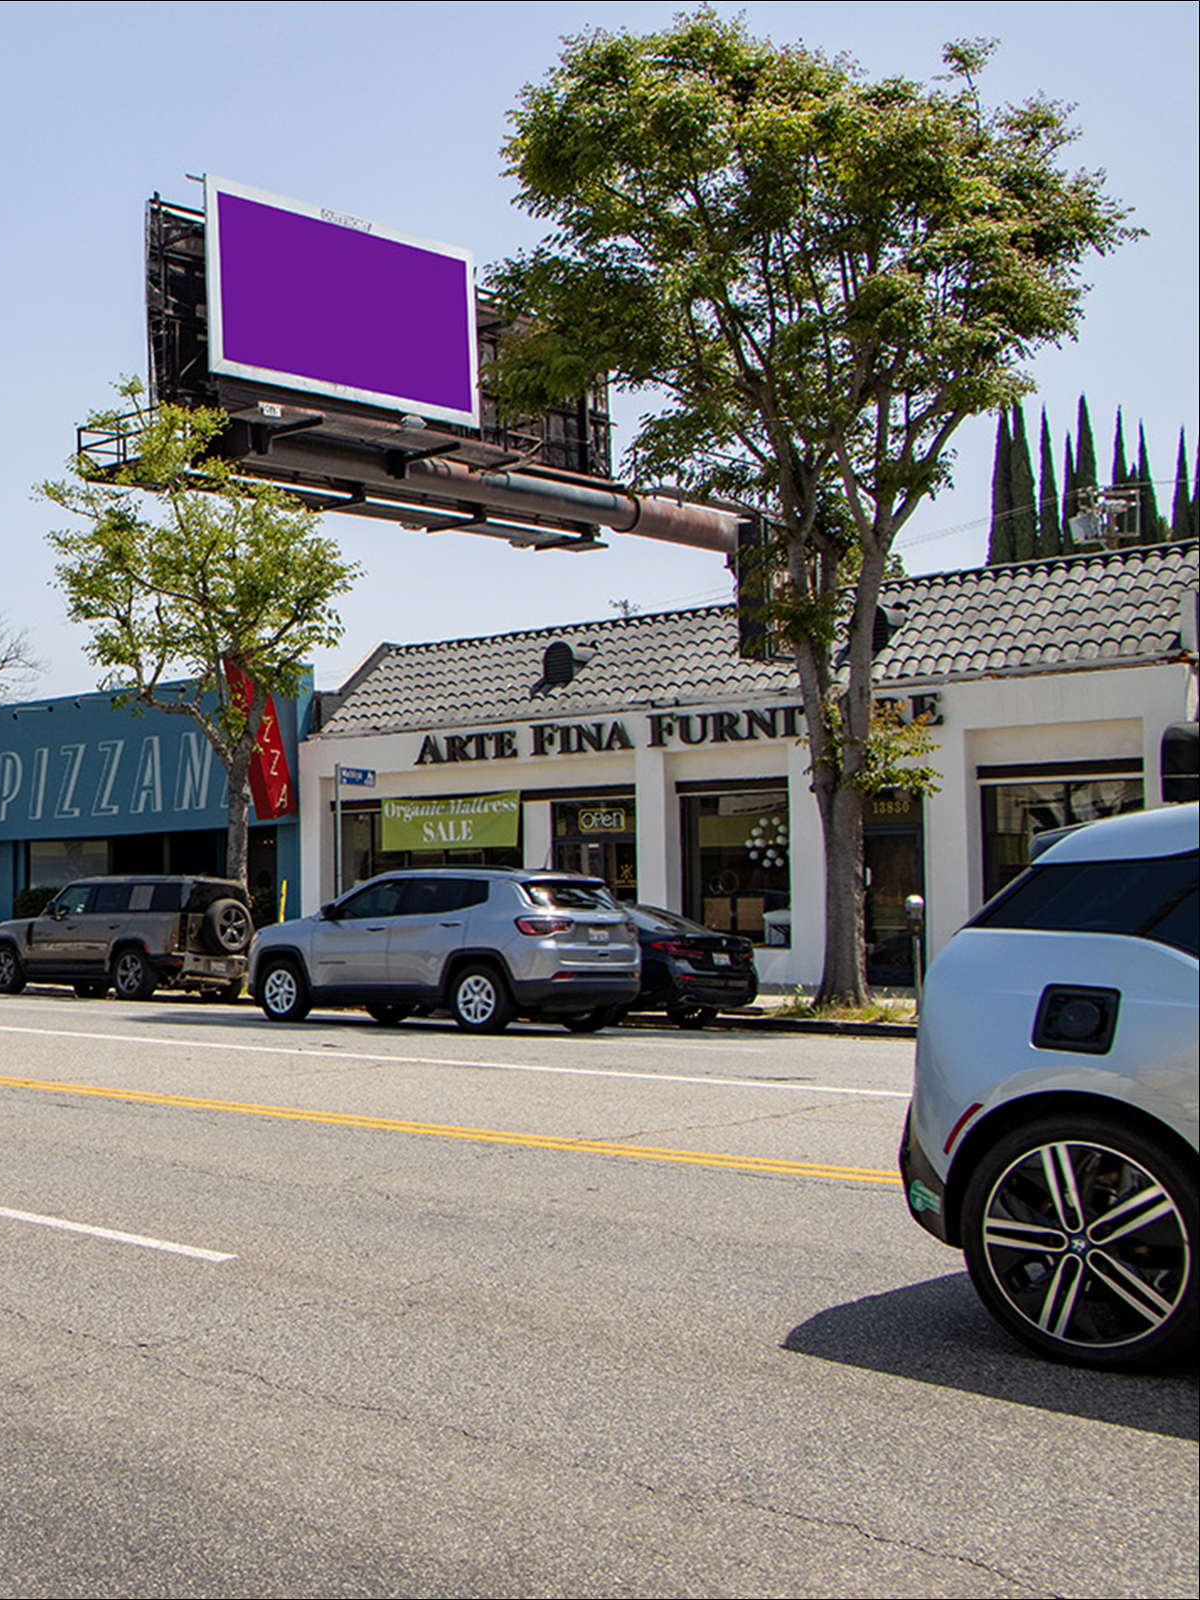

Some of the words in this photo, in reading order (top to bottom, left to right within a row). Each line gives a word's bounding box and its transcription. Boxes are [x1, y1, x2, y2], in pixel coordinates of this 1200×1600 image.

[415, 730, 518, 765] ARTE
[530, 719, 635, 757] FINA
[647, 692, 944, 747] FURNIRE
[384, 801, 445, 822] Organic
[450, 798, 518, 816] Mattress
[873, 800, 910, 814] 13830
[423, 820, 473, 843] SALE
